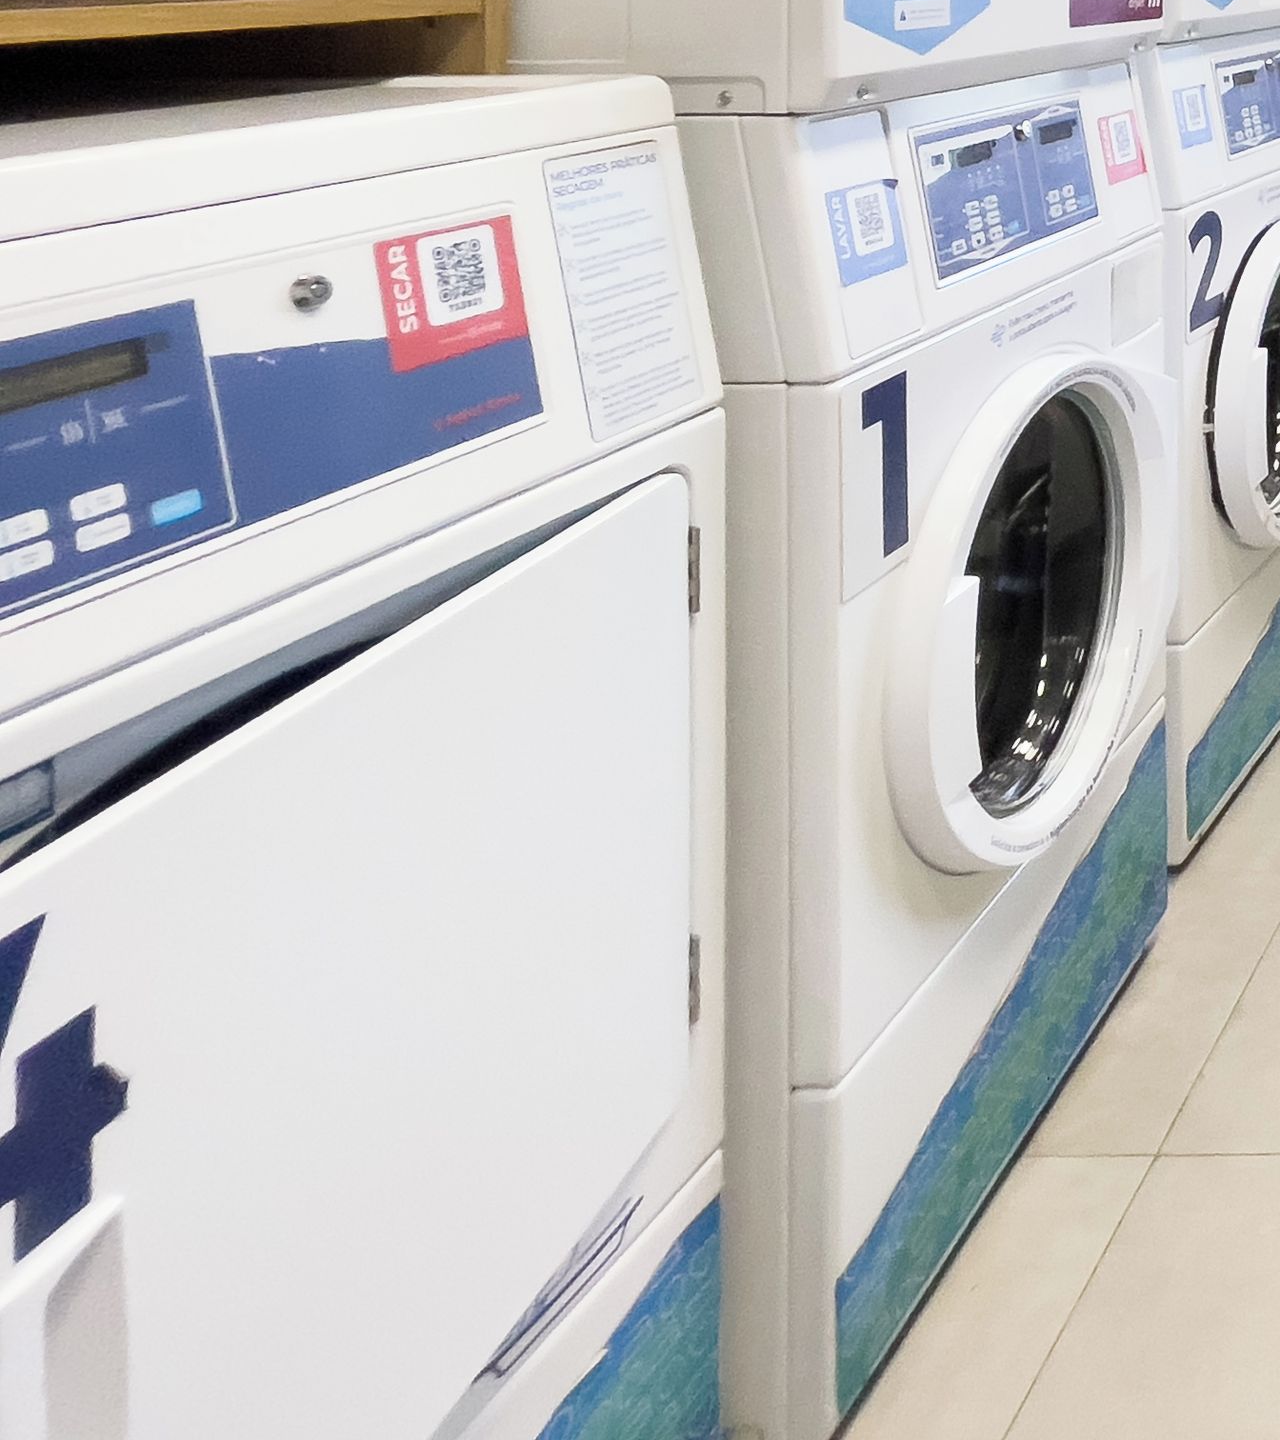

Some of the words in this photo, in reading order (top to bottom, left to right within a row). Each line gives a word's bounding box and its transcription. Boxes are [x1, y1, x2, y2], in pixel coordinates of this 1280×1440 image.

[551, 162, 609, 182] MELHORES
[552, 177, 605, 198] SECAGEM
[831, 196, 851, 259] LAVAR
[387, 244, 420, 334] SECAR
[1188, 210, 1225, 332] 2
[861, 370, 909, 558] 1
